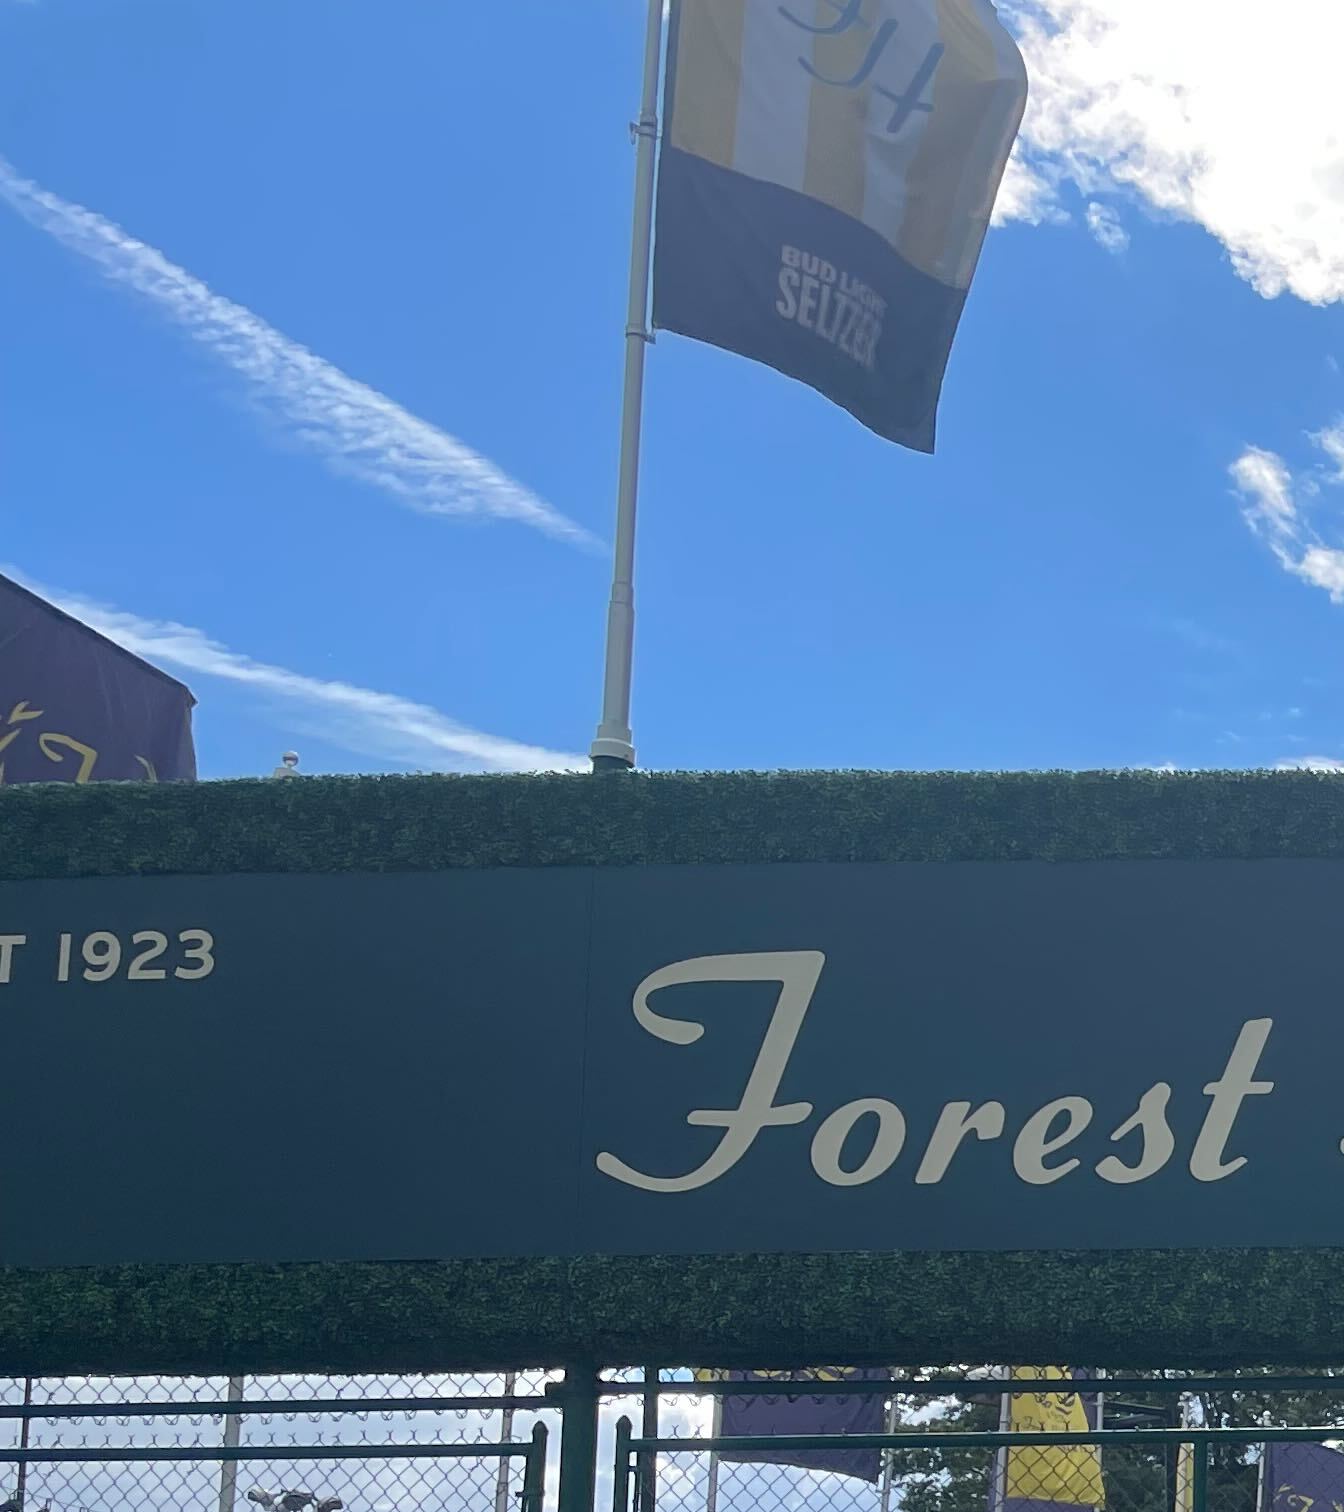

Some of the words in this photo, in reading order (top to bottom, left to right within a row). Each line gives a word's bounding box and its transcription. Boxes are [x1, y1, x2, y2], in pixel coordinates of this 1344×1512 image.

[781, 244, 837, 281] BUD
[776, 267, 883, 373] SELTZER
[57, 929, 216, 983] 1923
[596, 950, 1274, 1192] Forest
